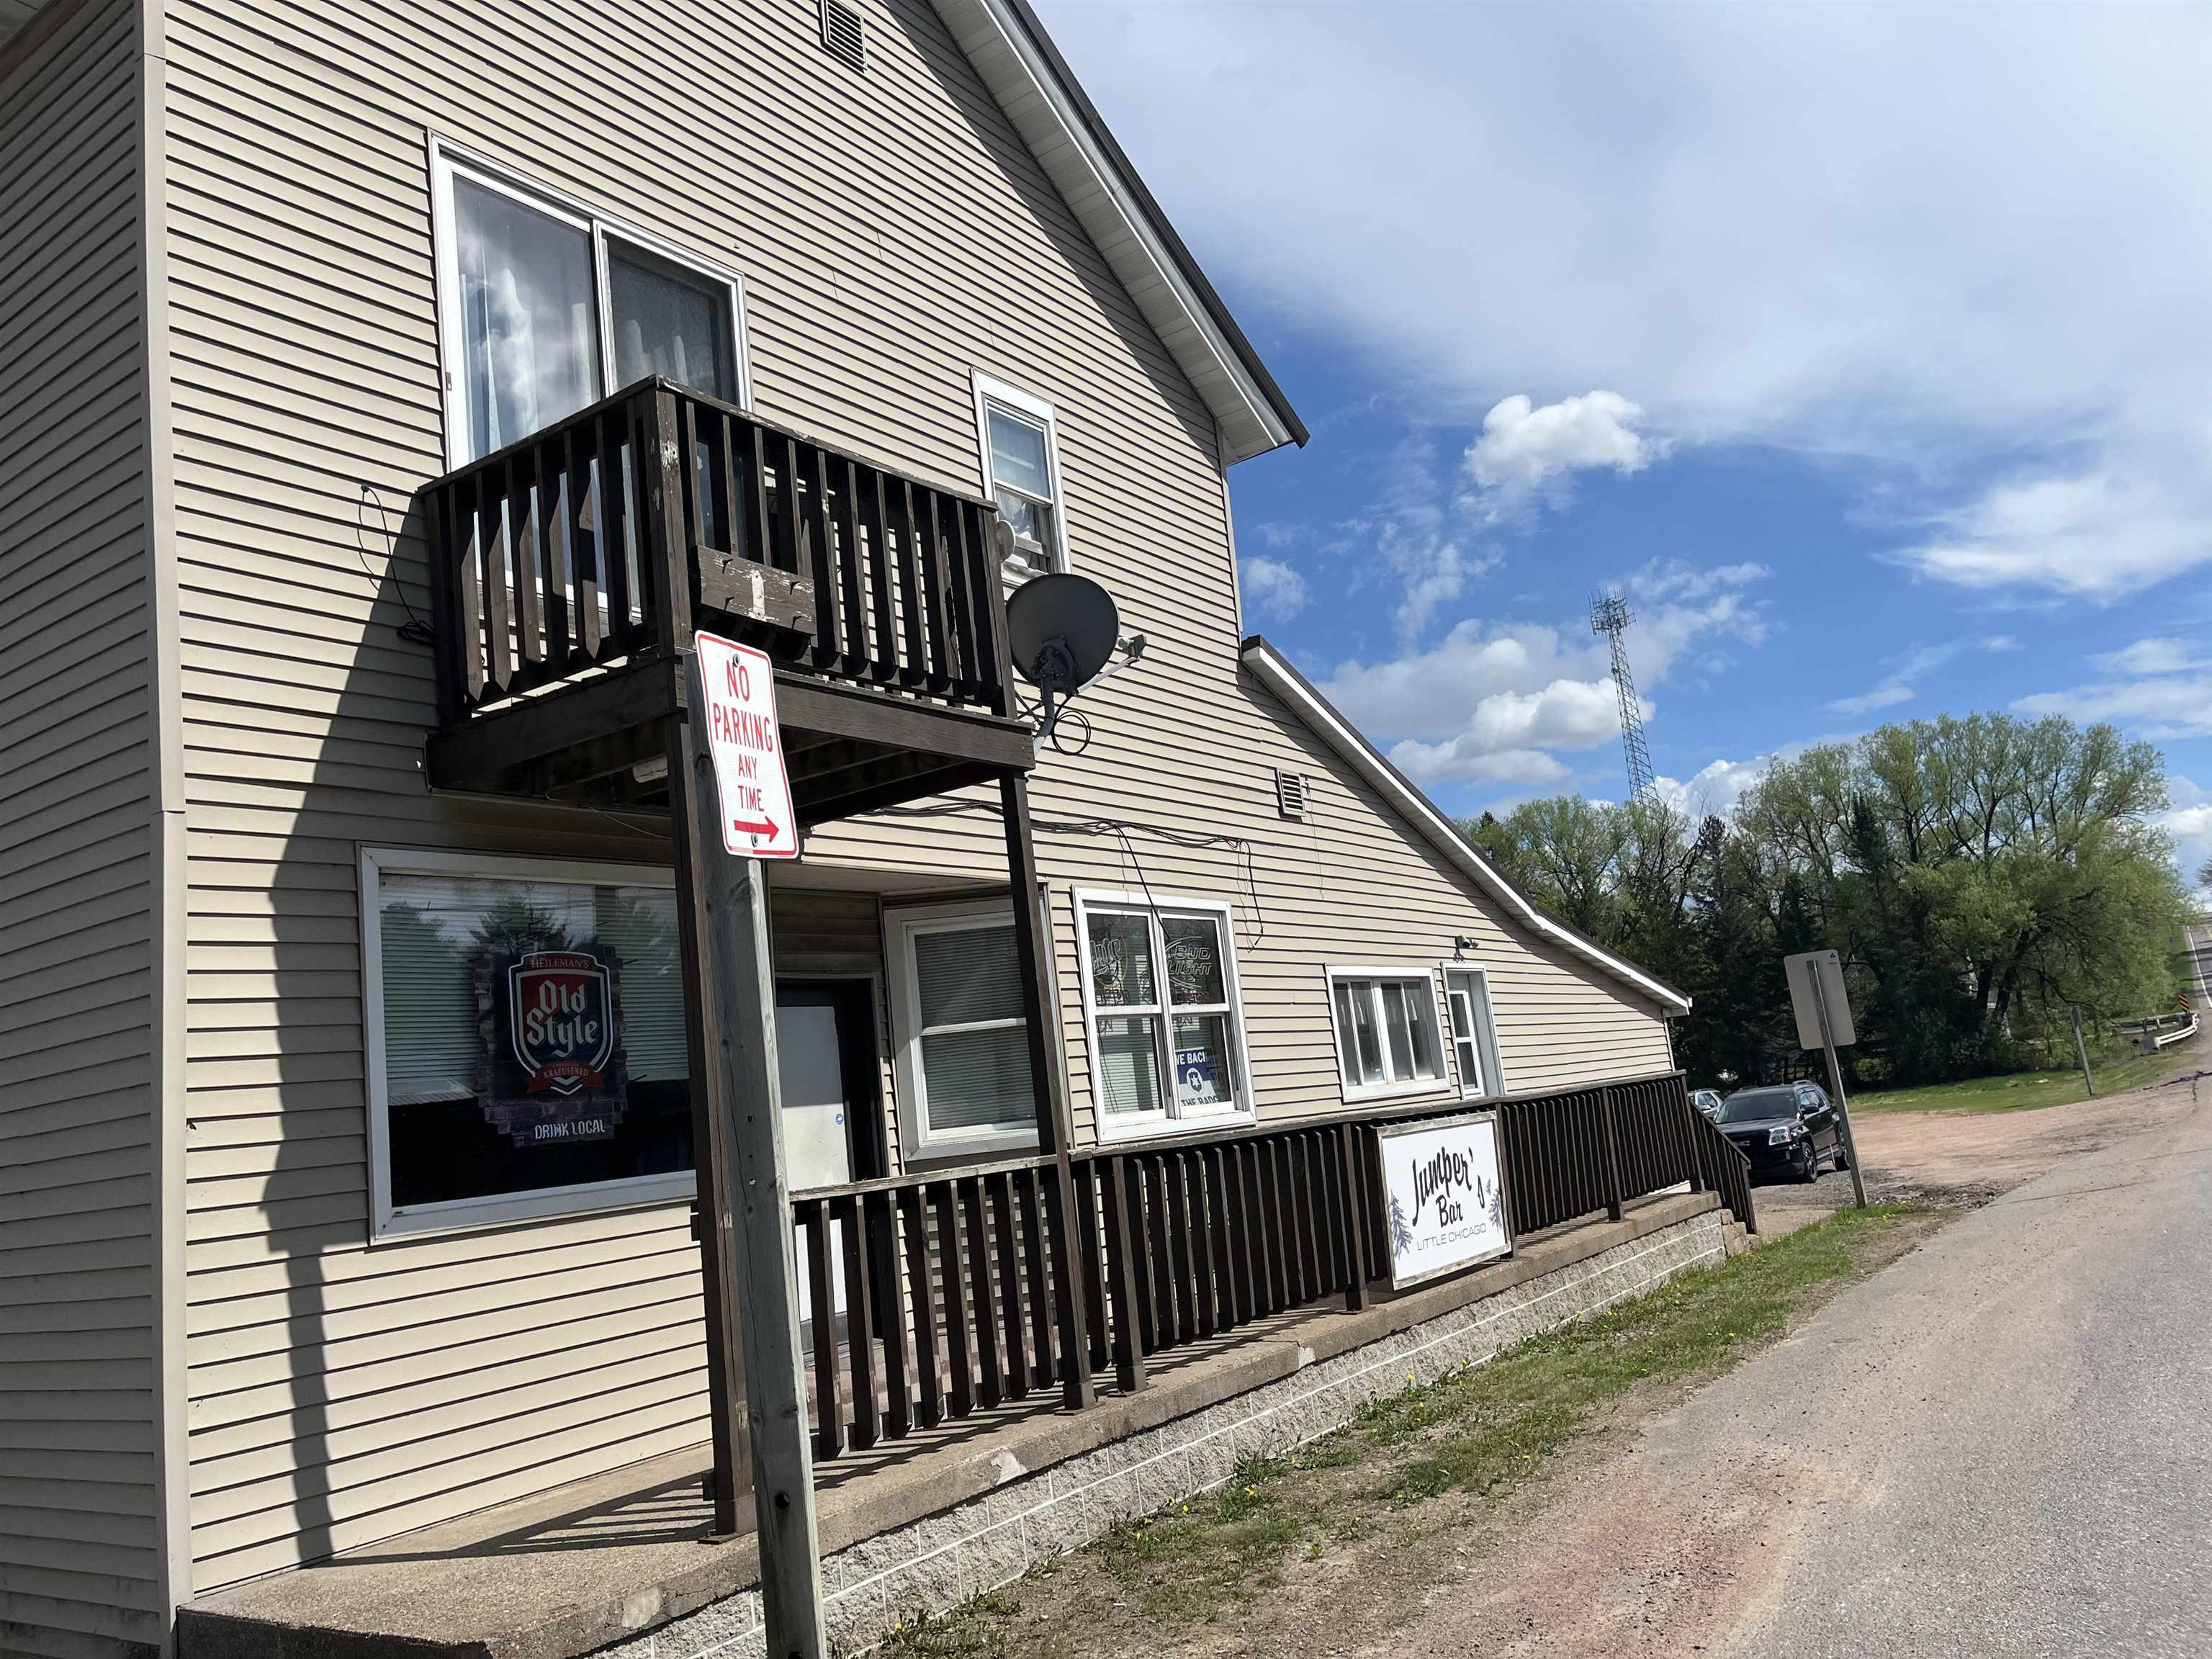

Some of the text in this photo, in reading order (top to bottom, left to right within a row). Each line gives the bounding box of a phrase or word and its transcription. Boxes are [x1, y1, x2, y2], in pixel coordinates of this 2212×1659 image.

[727, 661, 750, 703] NO
[713, 702, 773, 752] PARKING
[738, 754, 757, 781] ANY
[737, 785, 764, 812] TIME
[531, 956, 590, 968] HEILEMAN'S
[1174, 945, 1211, 960] BUD
[1168, 960, 1213, 976] LIGHT
[539, 979, 588, 1014] Old
[526, 1007, 599, 1058] Style
[534, 1119, 606, 1140] DRINK LOCAL
[1435, 1195, 1464, 1228] Bar
[1417, 1223, 1487, 1251] LITTLE CHICAGO
